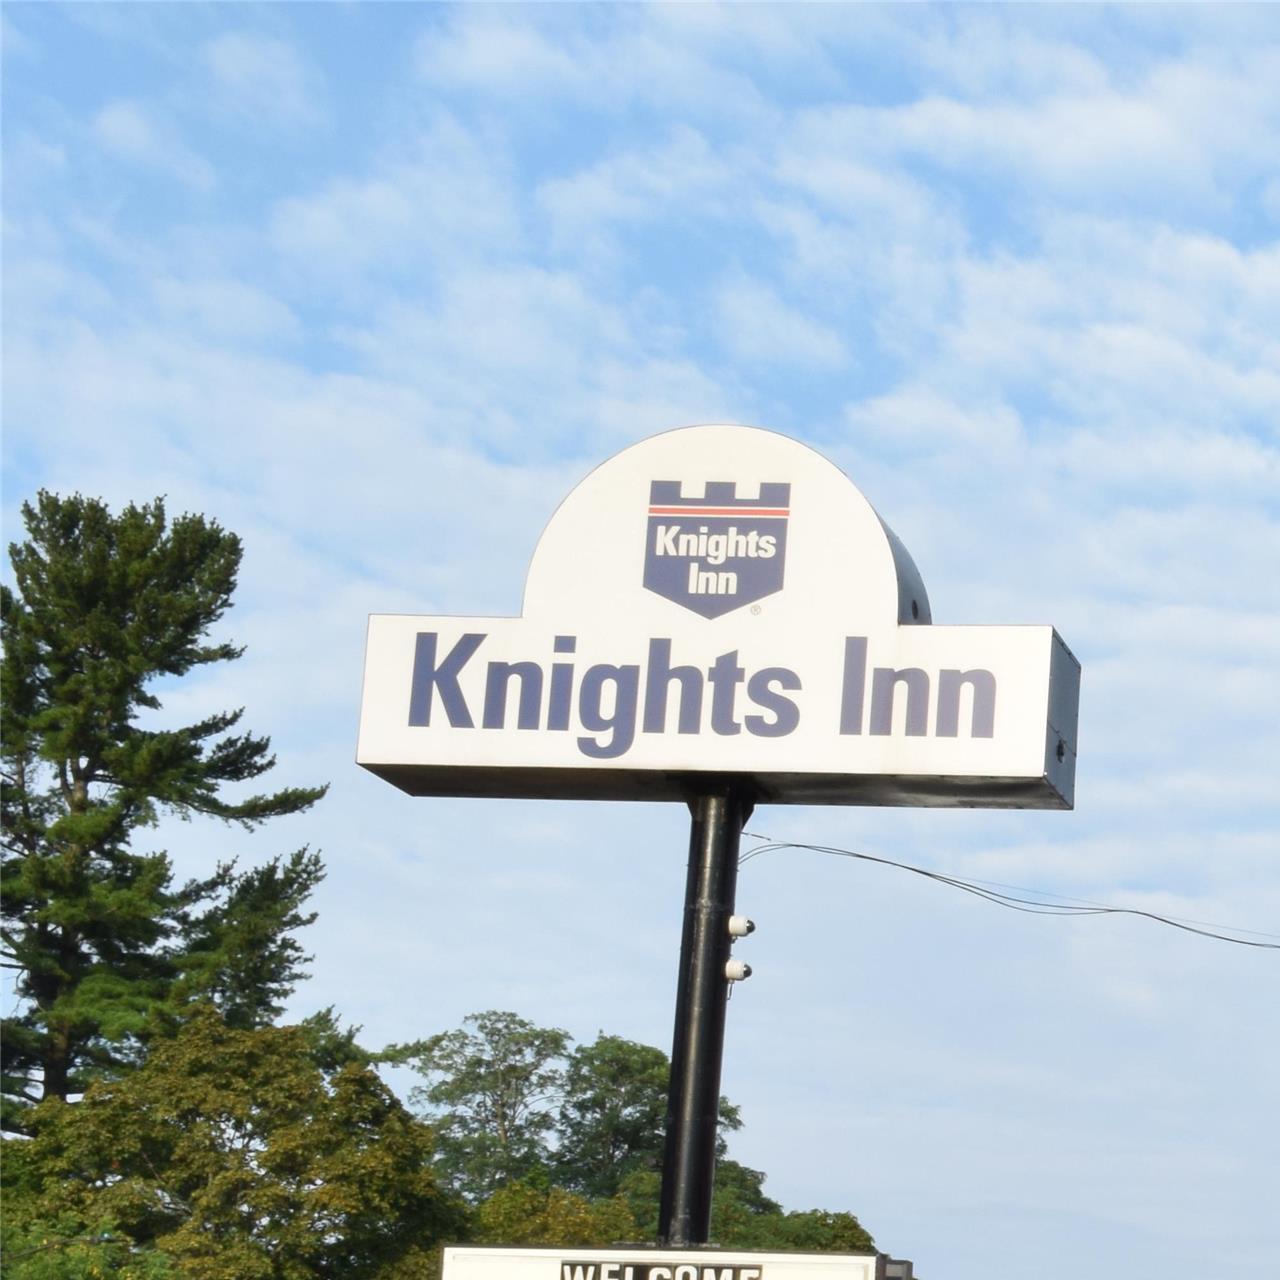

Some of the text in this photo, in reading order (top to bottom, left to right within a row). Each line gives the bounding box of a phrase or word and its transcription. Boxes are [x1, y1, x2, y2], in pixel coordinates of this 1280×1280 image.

[655, 526, 777, 564] Knights
[687, 563, 738, 595] Inn
[407, 631, 998, 759] Knights Inn
